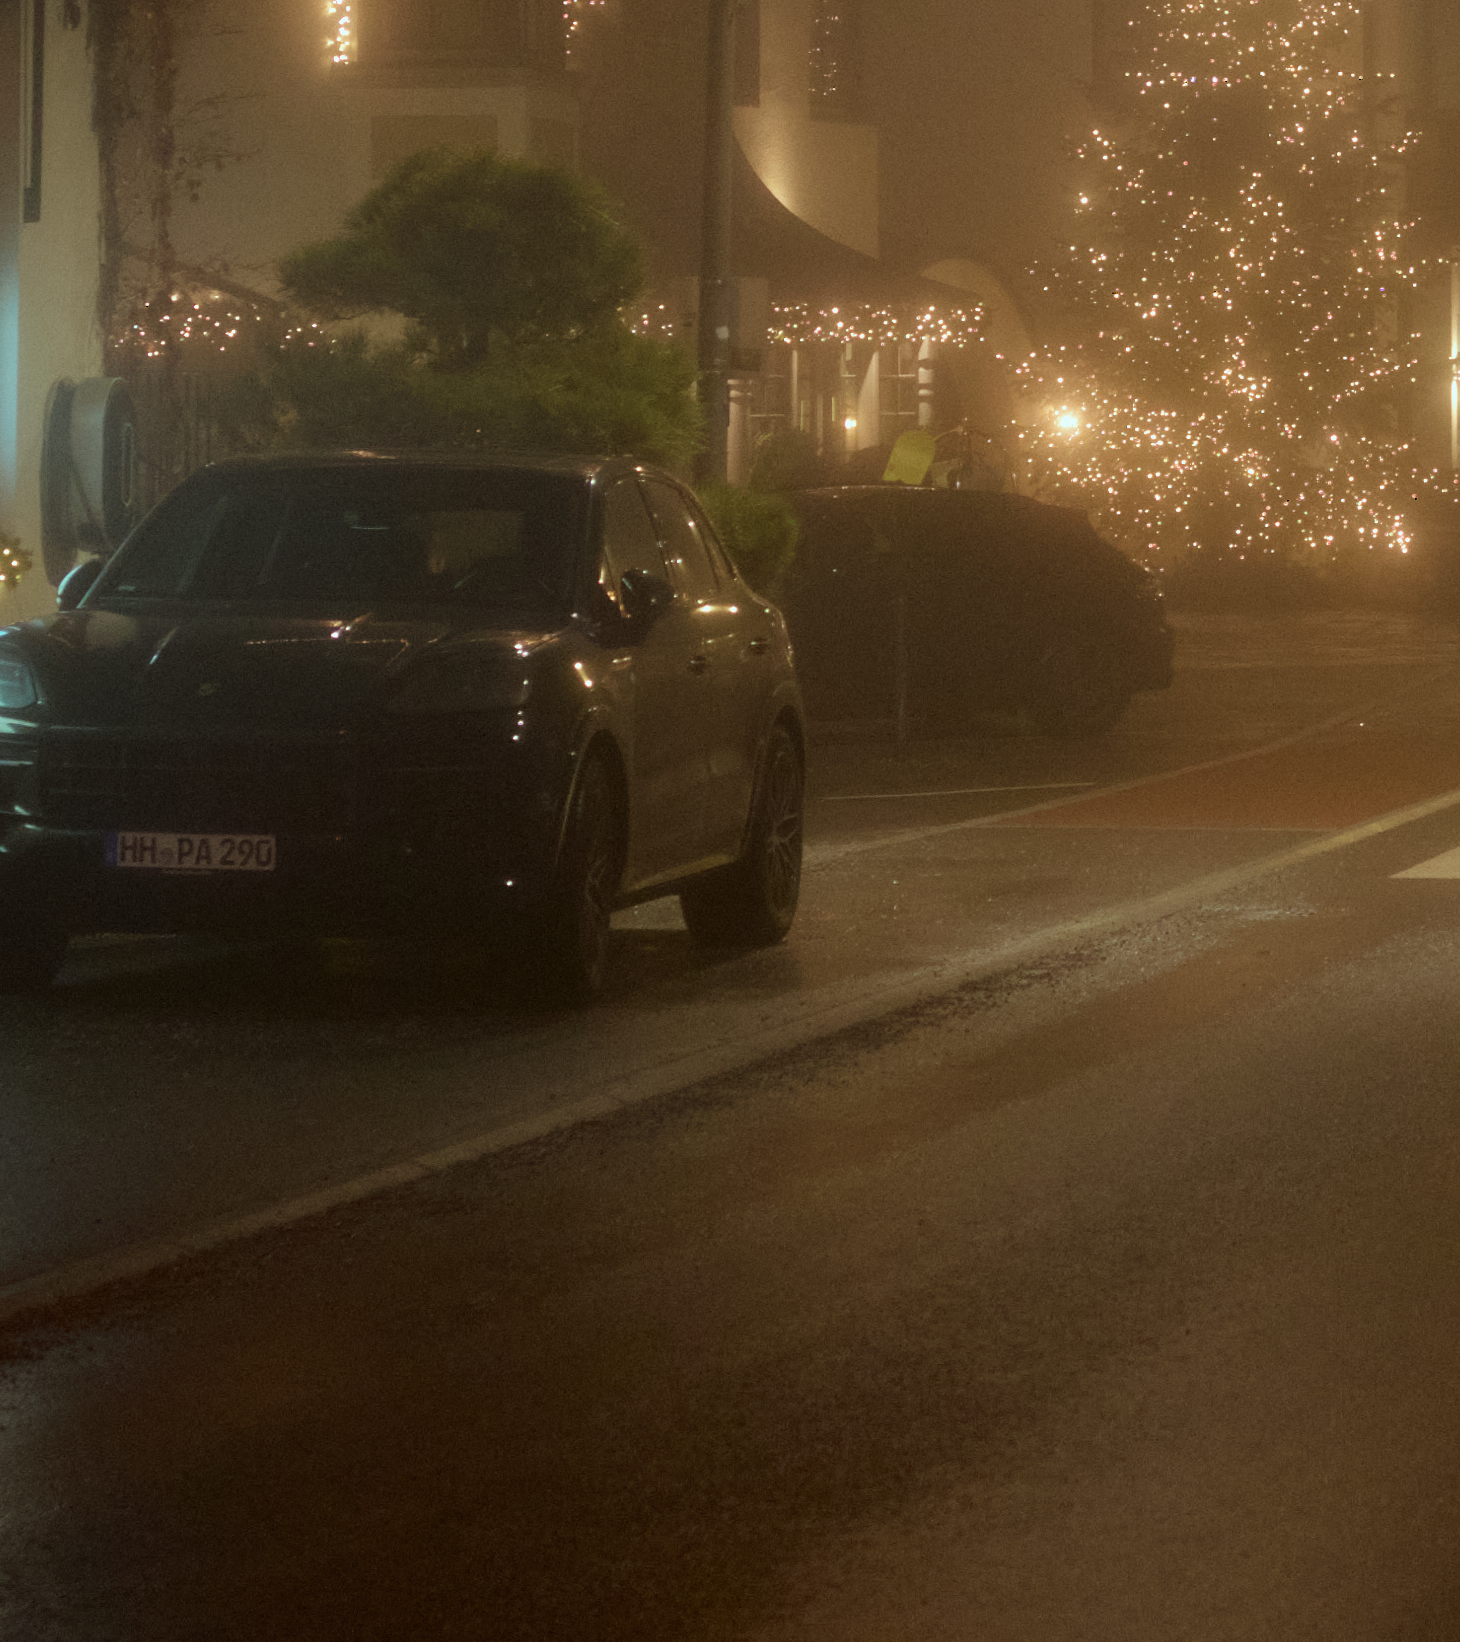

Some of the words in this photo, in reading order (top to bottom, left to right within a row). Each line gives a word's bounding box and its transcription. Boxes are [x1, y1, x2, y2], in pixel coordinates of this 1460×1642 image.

[120, 835, 157, 864] HH
[177, 837, 211, 866] PA
[219, 838, 272, 867] 290
